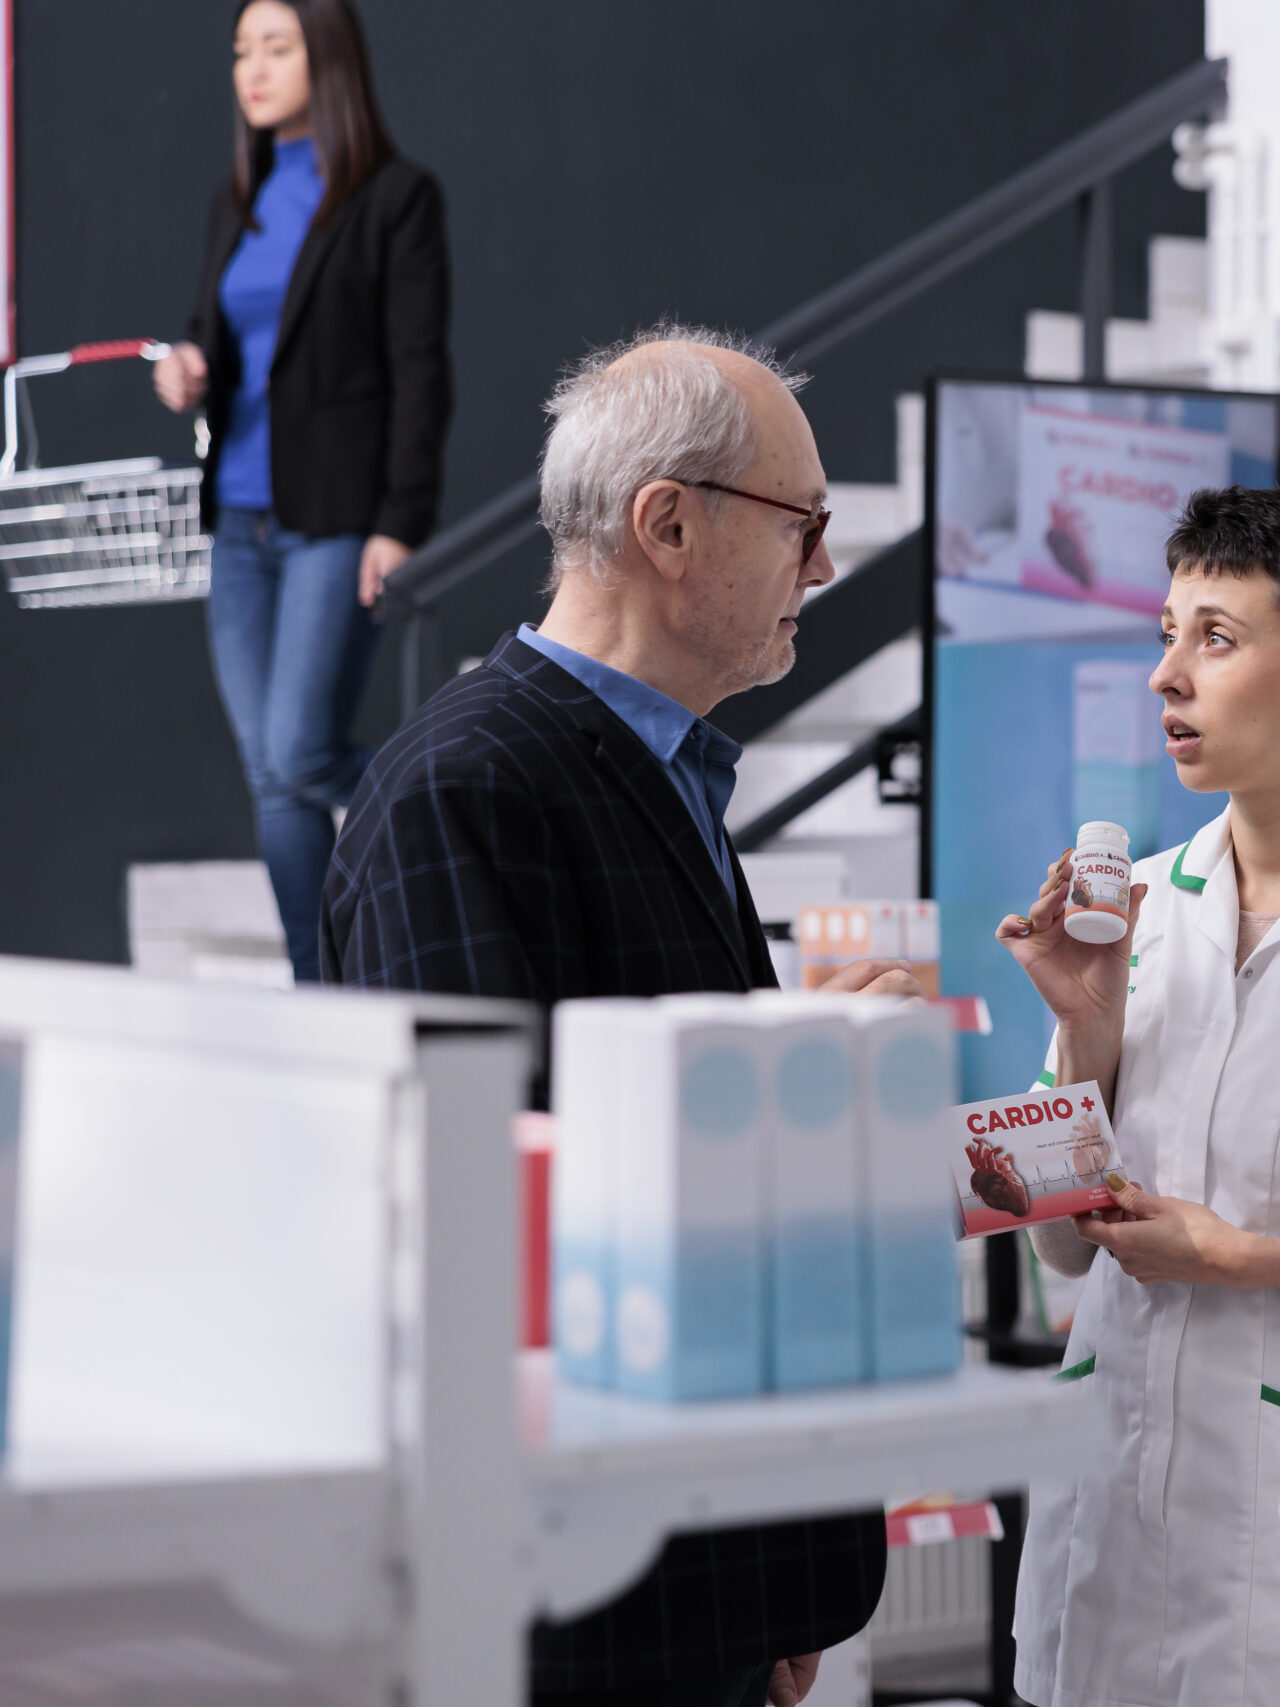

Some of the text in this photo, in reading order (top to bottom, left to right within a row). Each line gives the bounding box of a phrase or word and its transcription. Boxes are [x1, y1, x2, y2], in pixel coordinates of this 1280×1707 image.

[1058, 466, 1178, 510] CARDIO
[1078, 864, 1125, 879] CARDIO
[967, 1098, 1073, 1134] CARDIO
